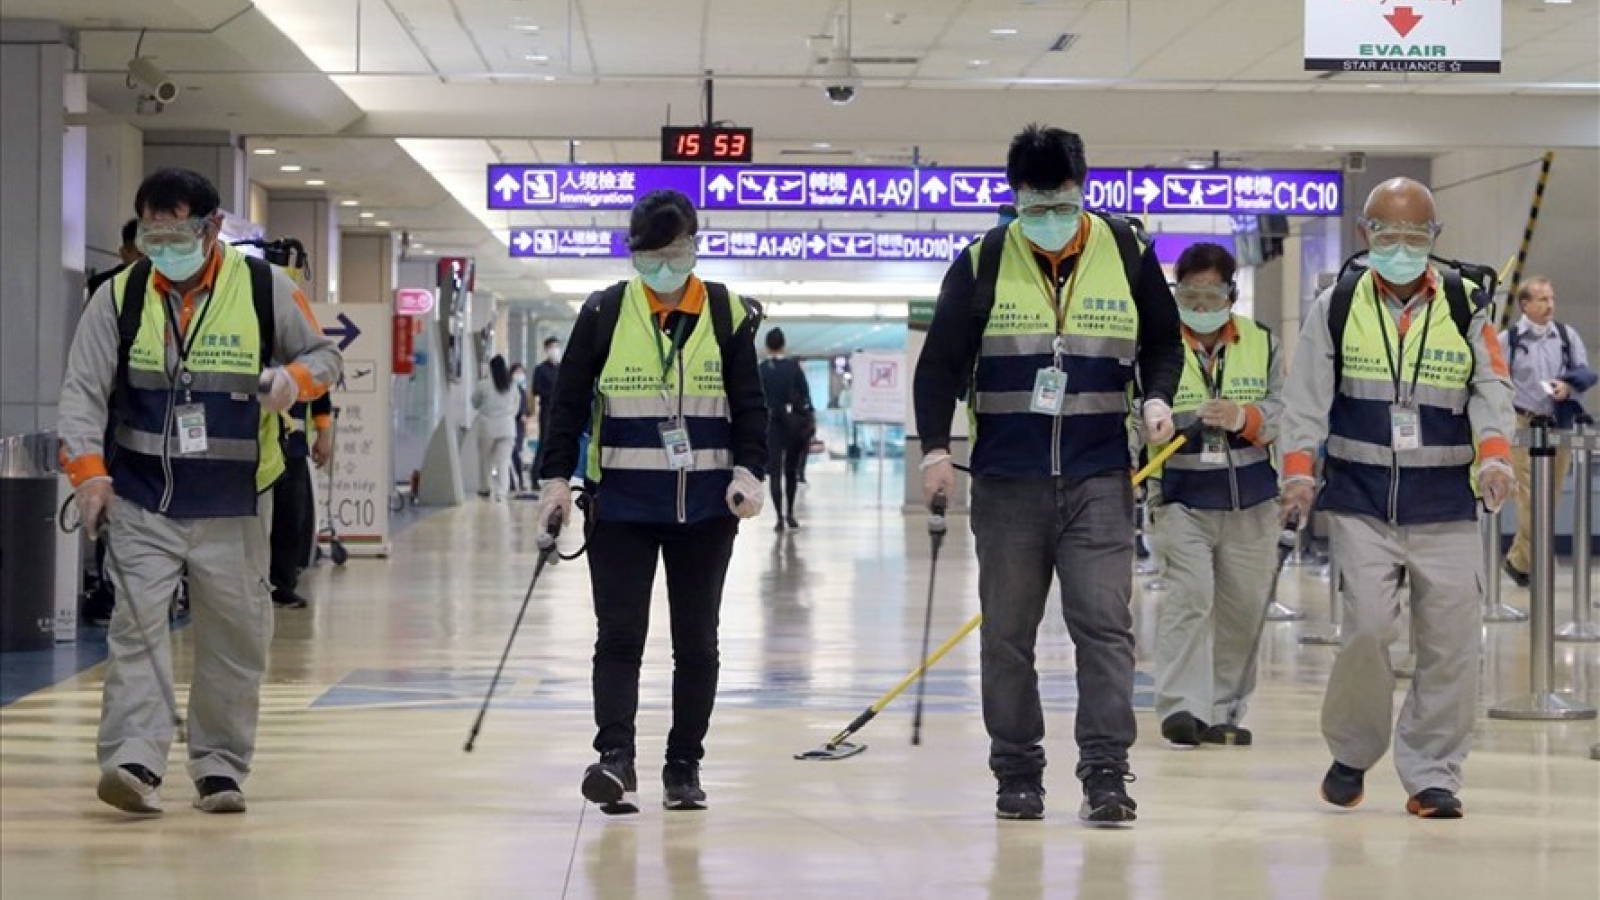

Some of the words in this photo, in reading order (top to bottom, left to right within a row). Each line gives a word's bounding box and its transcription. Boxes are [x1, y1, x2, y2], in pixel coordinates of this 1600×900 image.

[1359, 44, 1405, 56] EVA
[1406, 45, 1446, 57] AIR
[1343, 61, 1377, 72] STAR
[1380, 62, 1446, 72] ALLIANCE
[677, 134, 700, 156] 15
[714, 134, 746, 156] 53
[560, 171, 635, 190] 入境檢查
[559, 191, 634, 207] Immigration
[849, 178, 913, 205] A1-A9
[1085, 181, 1125, 209] -D10
[1274, 181, 1338, 210] C1-C10
[758, 236, 802, 256] A1-A9
[904, 238, 948, 259] D1-D10
